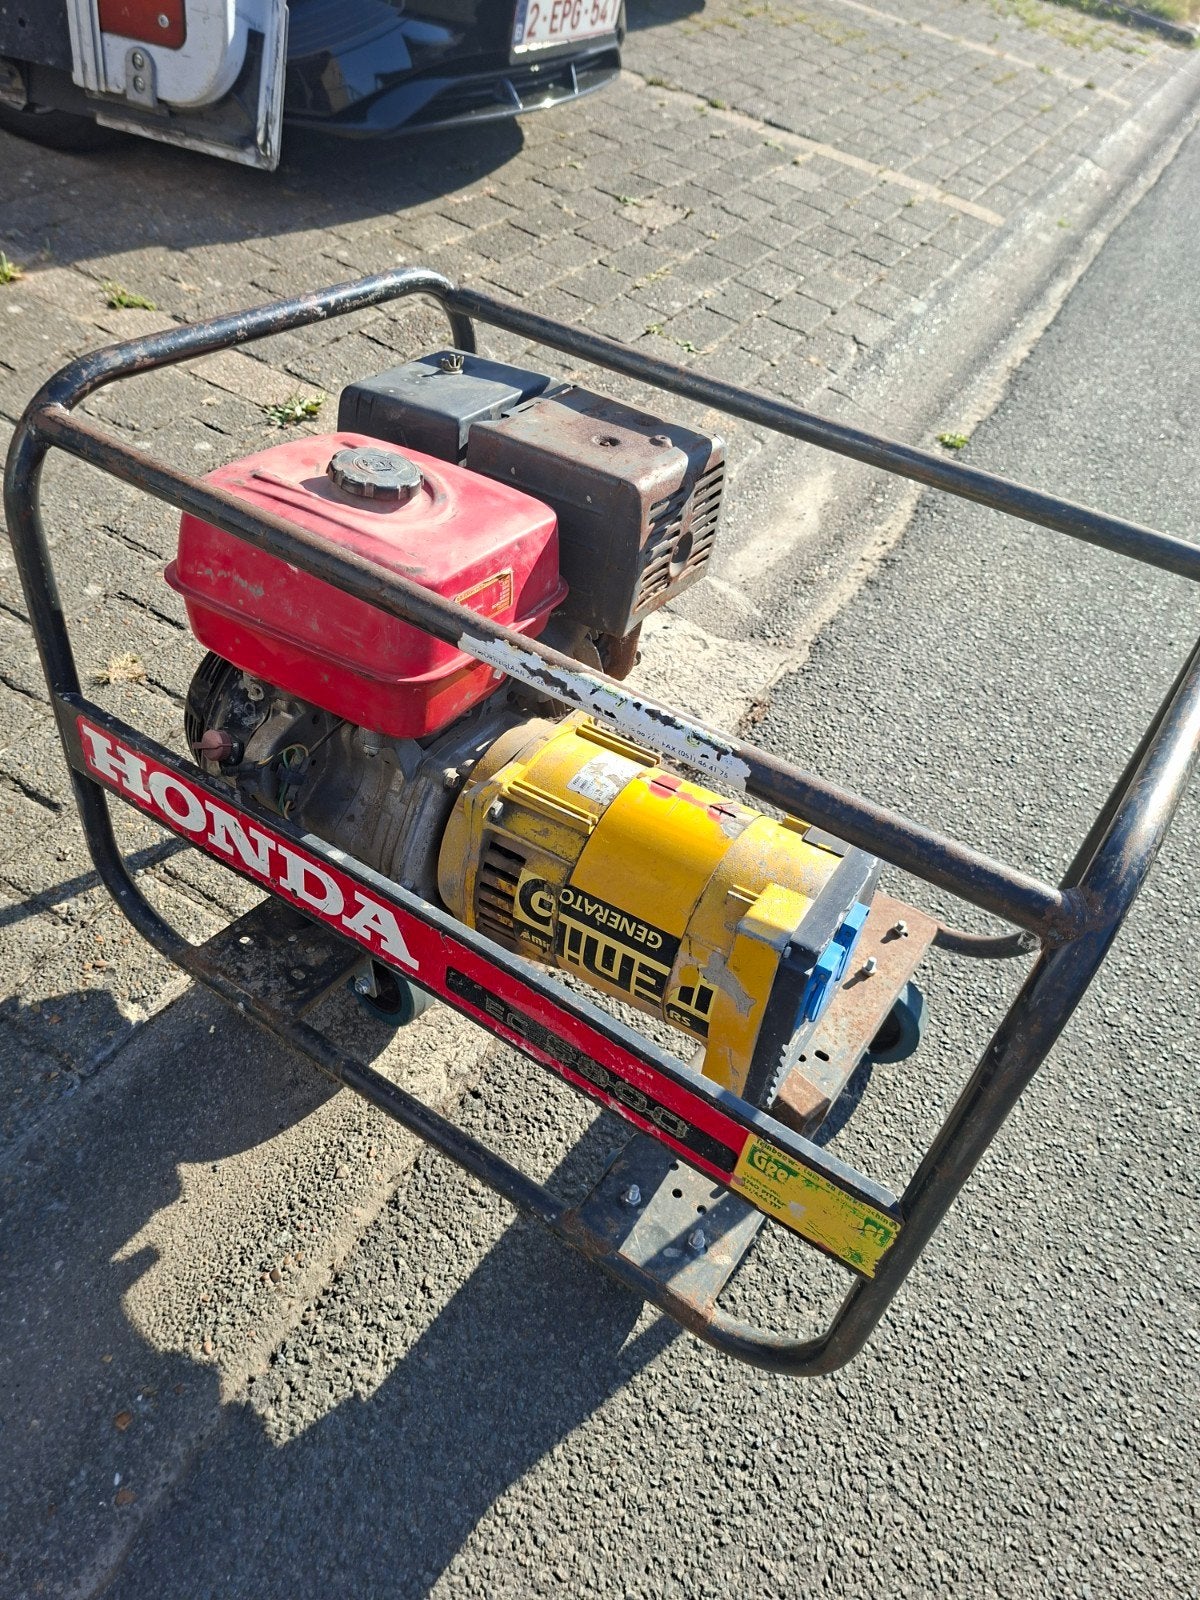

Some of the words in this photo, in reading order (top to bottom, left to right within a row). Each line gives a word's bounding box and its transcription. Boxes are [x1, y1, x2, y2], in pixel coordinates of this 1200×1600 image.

[82, 725, 419, 971] HONDA
[559, 888, 664, 950] GENERATO
[485, 996, 528, 1036] EC
